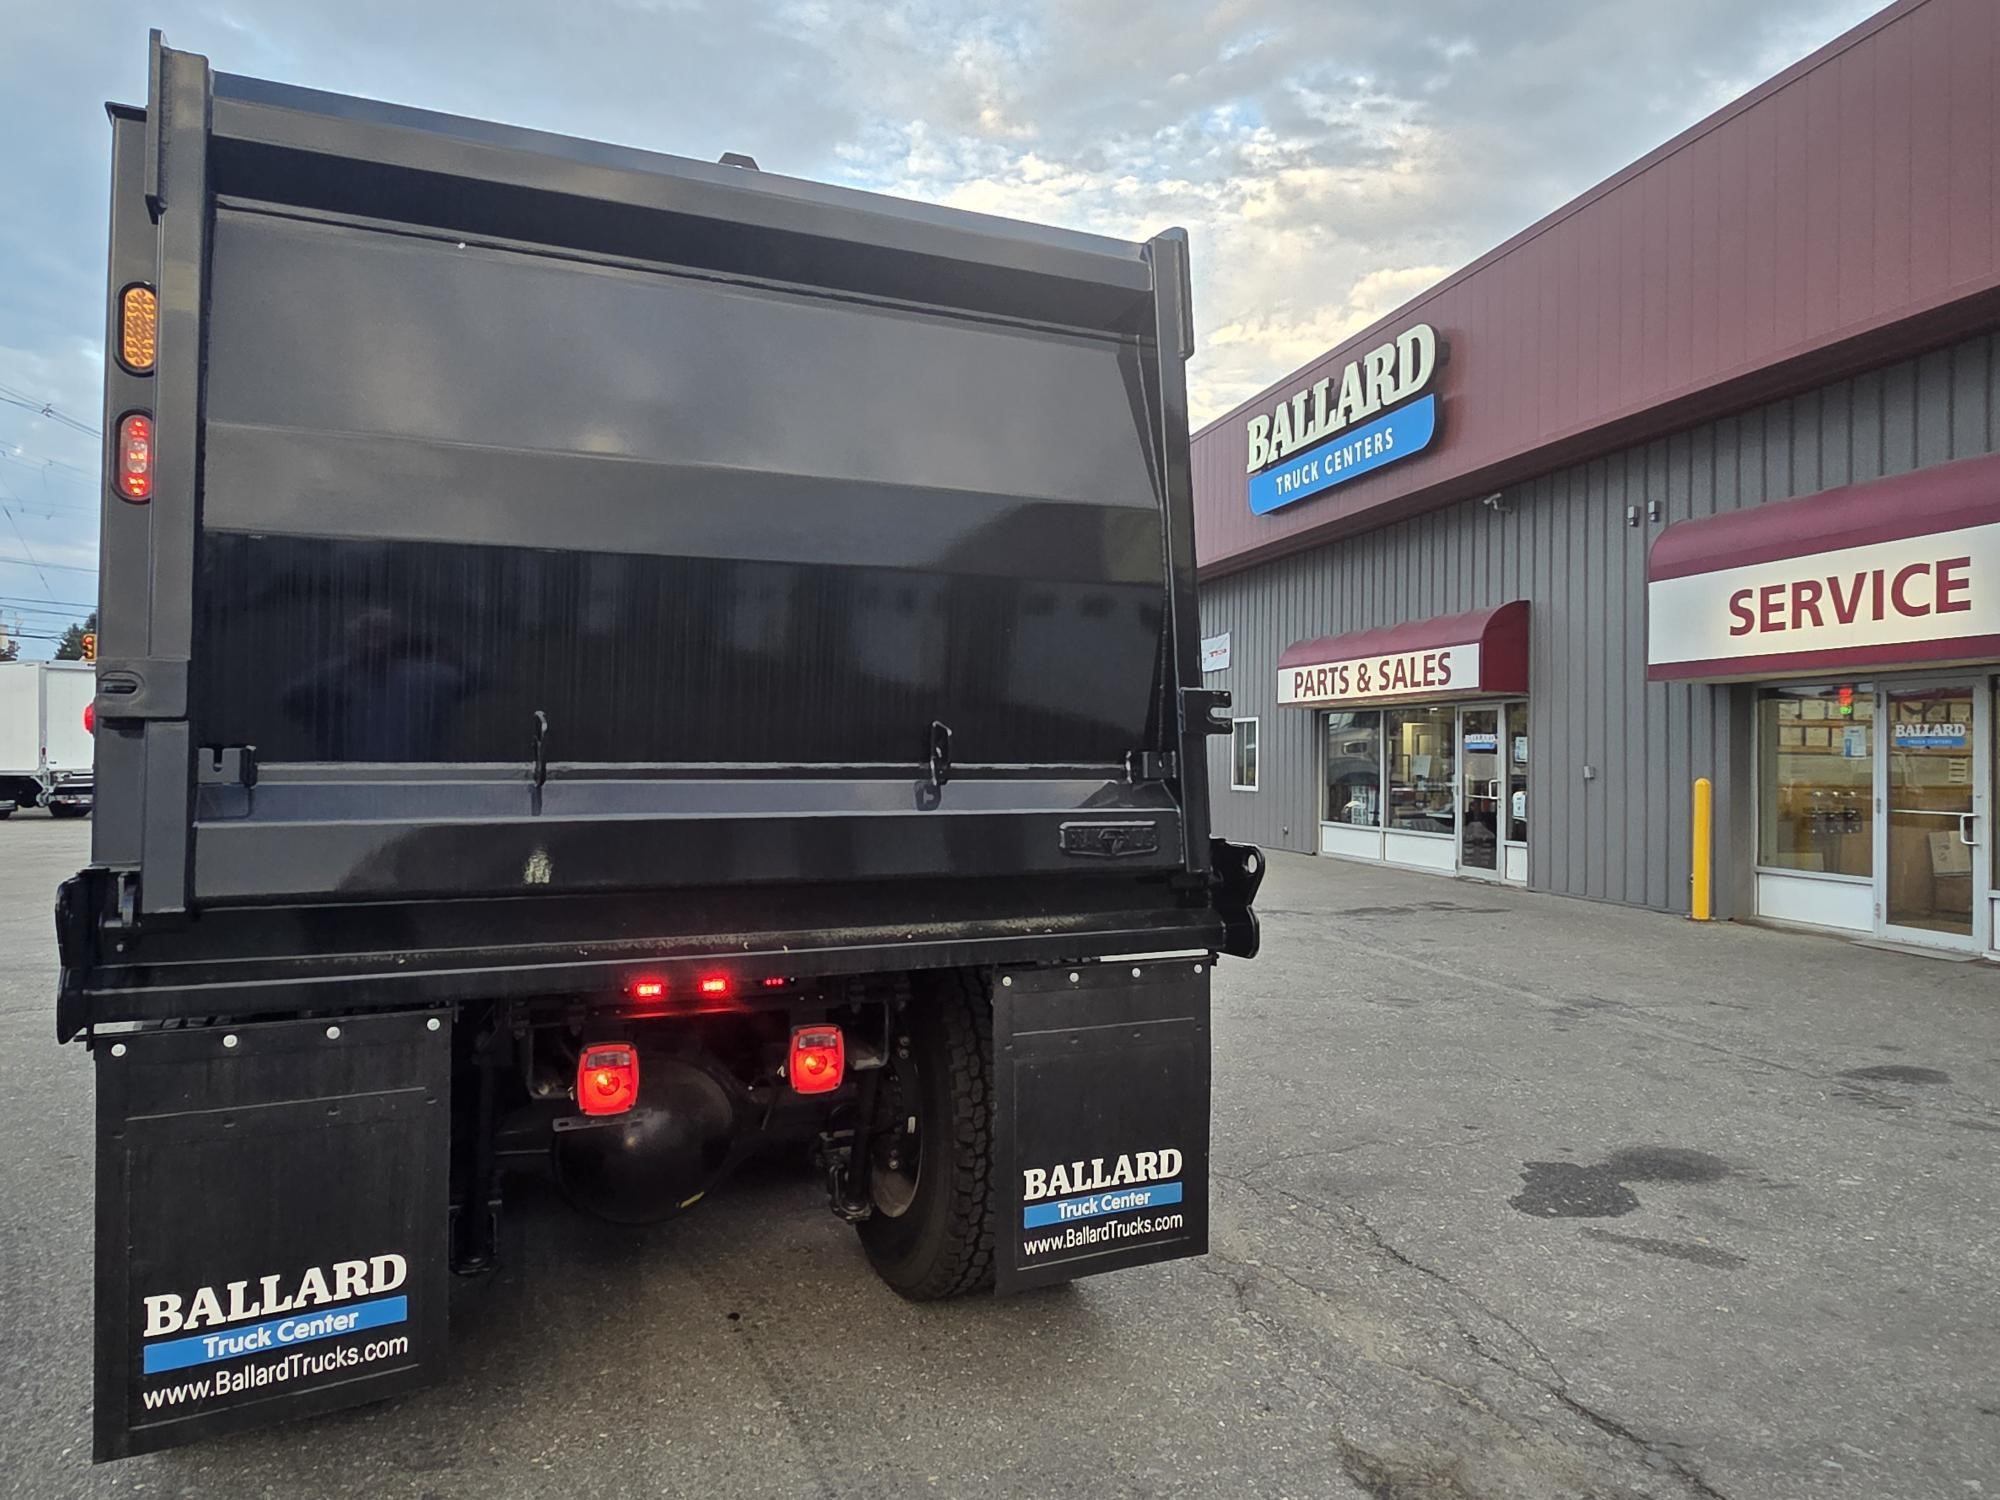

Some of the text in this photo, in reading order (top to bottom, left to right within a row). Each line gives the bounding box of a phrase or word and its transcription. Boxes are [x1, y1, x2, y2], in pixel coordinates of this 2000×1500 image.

[1246, 323, 1436, 474] BALLARD
[1276, 428, 1394, 496] TRUCK CENTERS
[1729, 556, 1971, 636] SERVICE
[1294, 652, 1452, 698] PARTS & SALES
[1895, 724, 1966, 737] BALLARD
[1023, 1148, 1183, 1201] BALLARD
[1058, 1191, 1151, 1219] Truck Center
[1024, 1214, 1183, 1256] www.BallardTrucks.com
[143, 1254, 407, 1337] BALLARD
[203, 1310, 359, 1358] Truck Center
[143, 1336, 408, 1409] www.BallardTrucks.com
